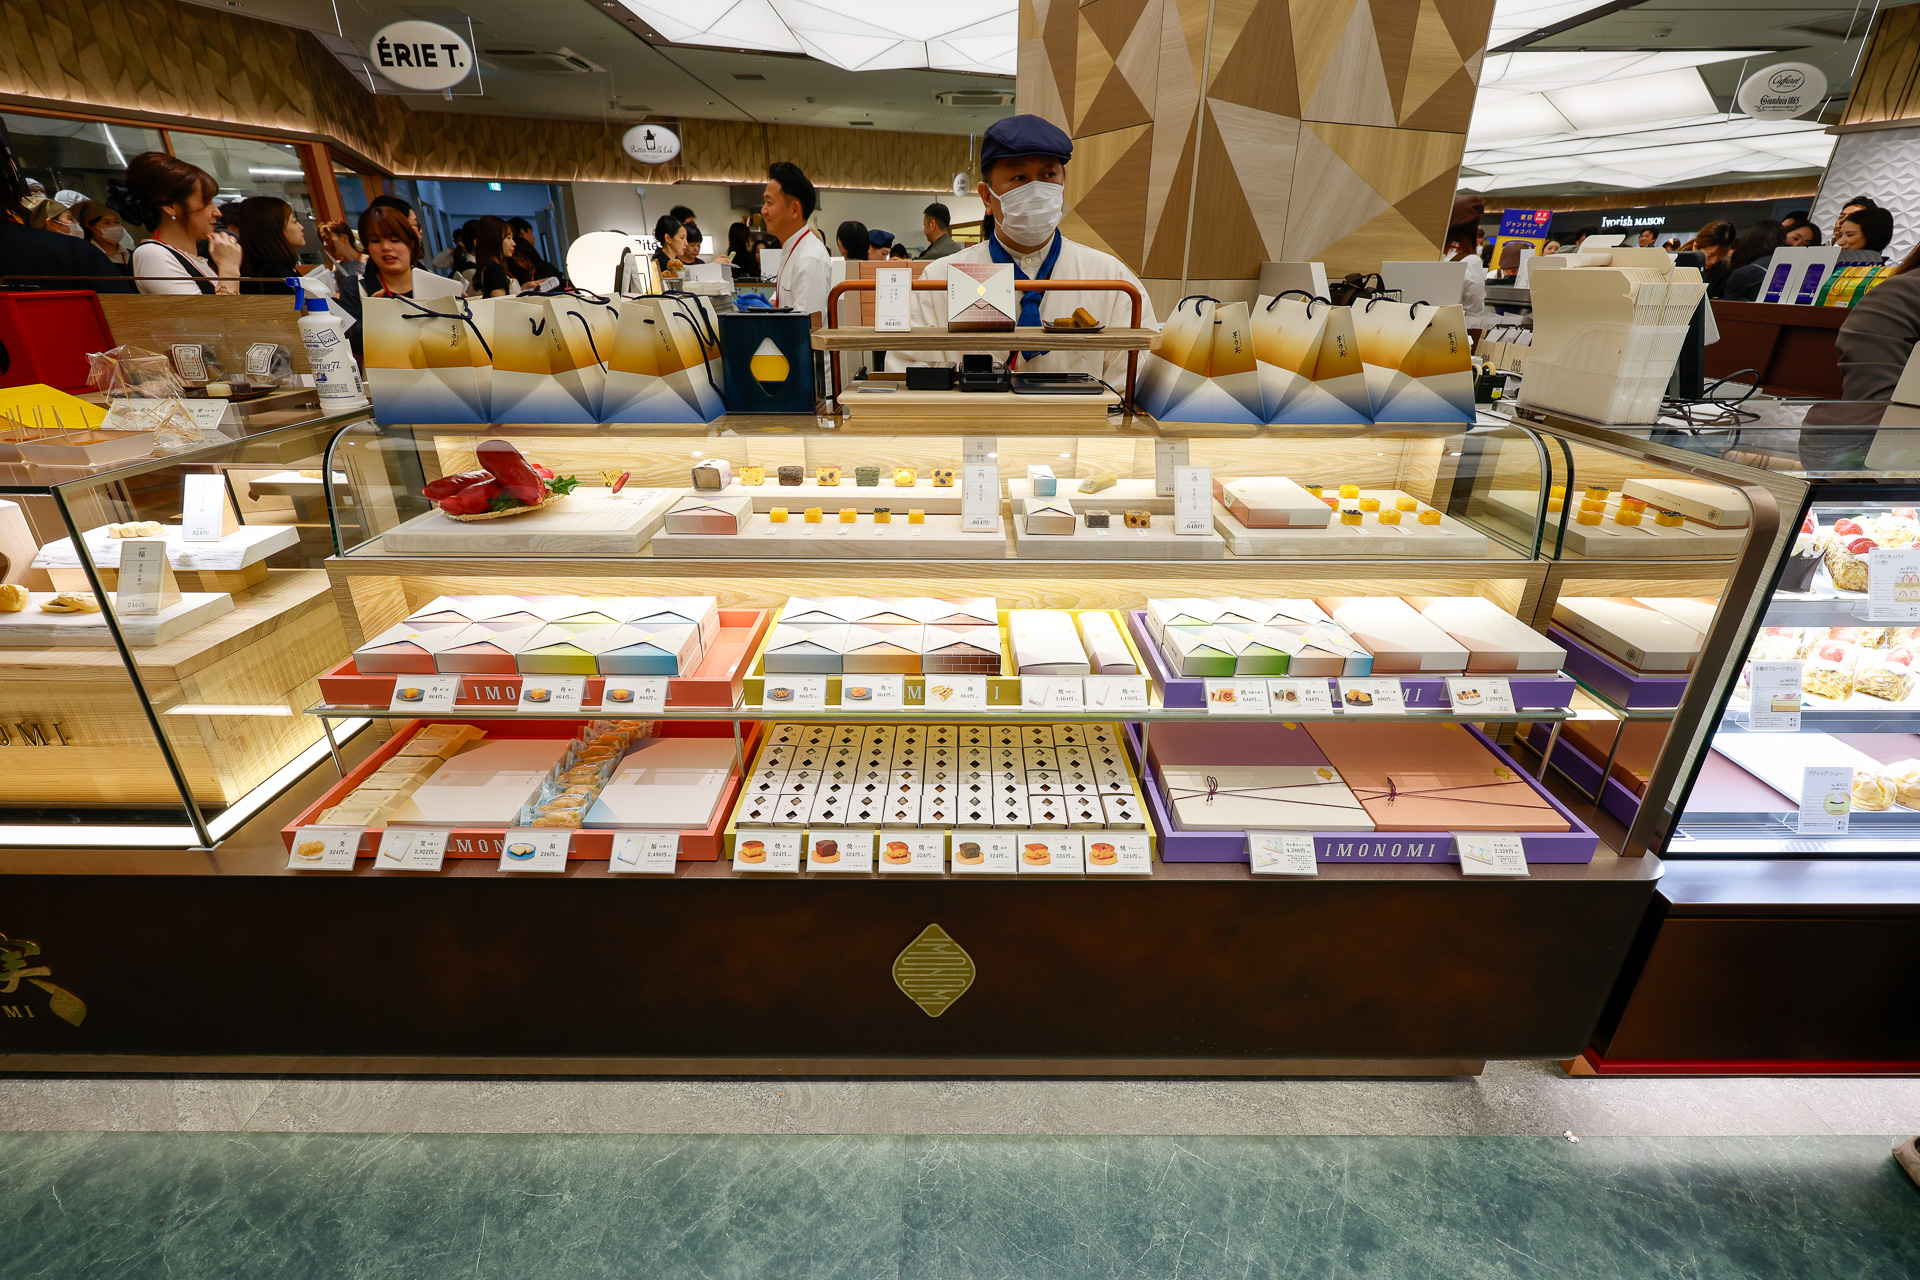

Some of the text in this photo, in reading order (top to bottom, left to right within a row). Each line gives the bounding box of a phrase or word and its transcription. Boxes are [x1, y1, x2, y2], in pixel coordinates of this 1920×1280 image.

[377, 36, 464, 67] ÉRIE T.
[1634, 217, 1665, 226] MAISON
[1325, 843, 1436, 857] IMONOMI
